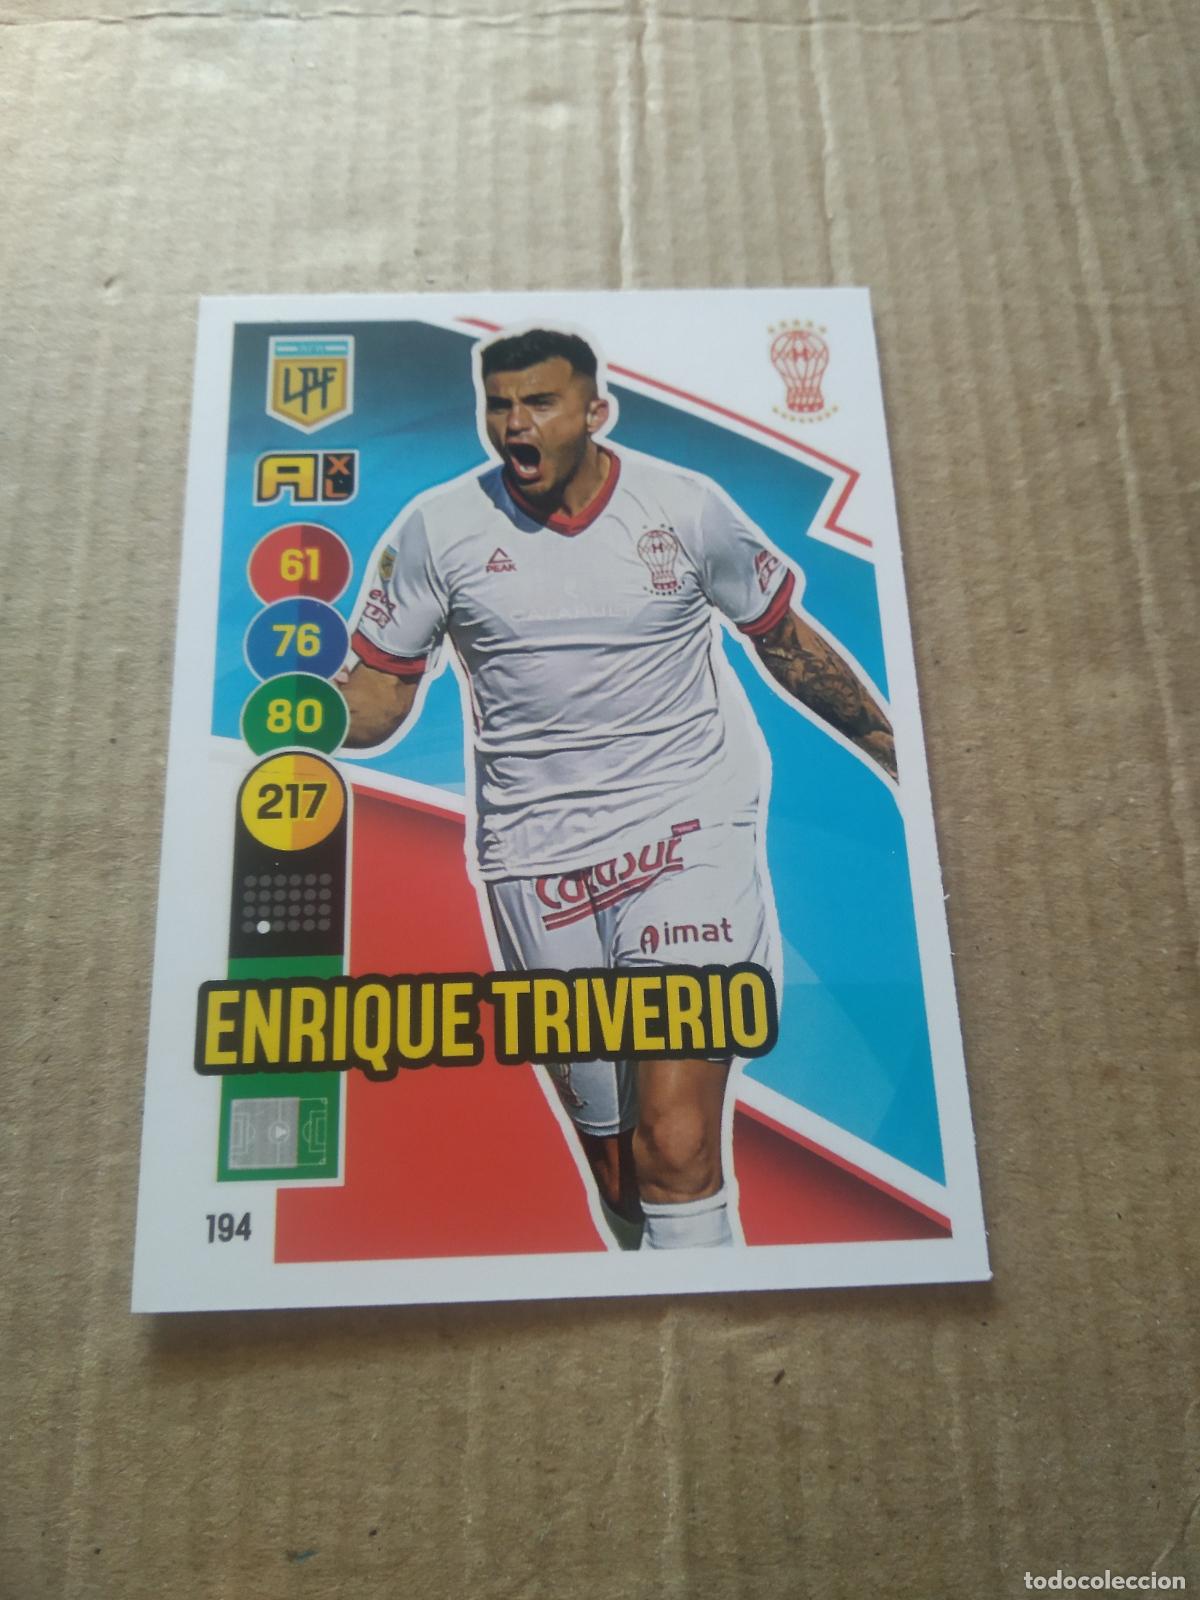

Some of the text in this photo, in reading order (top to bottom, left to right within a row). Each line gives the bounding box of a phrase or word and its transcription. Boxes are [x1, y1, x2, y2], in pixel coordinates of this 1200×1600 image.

[280, 548, 320, 581] 61
[485, 563, 518, 574] PEAK
[272, 623, 322, 658] 76
[266, 698, 324, 734] 80
[256, 783, 328, 821] 217
[203, 971, 770, 1072] ENRIQUE TRIVERIO
[206, 1211, 253, 1244] 194
